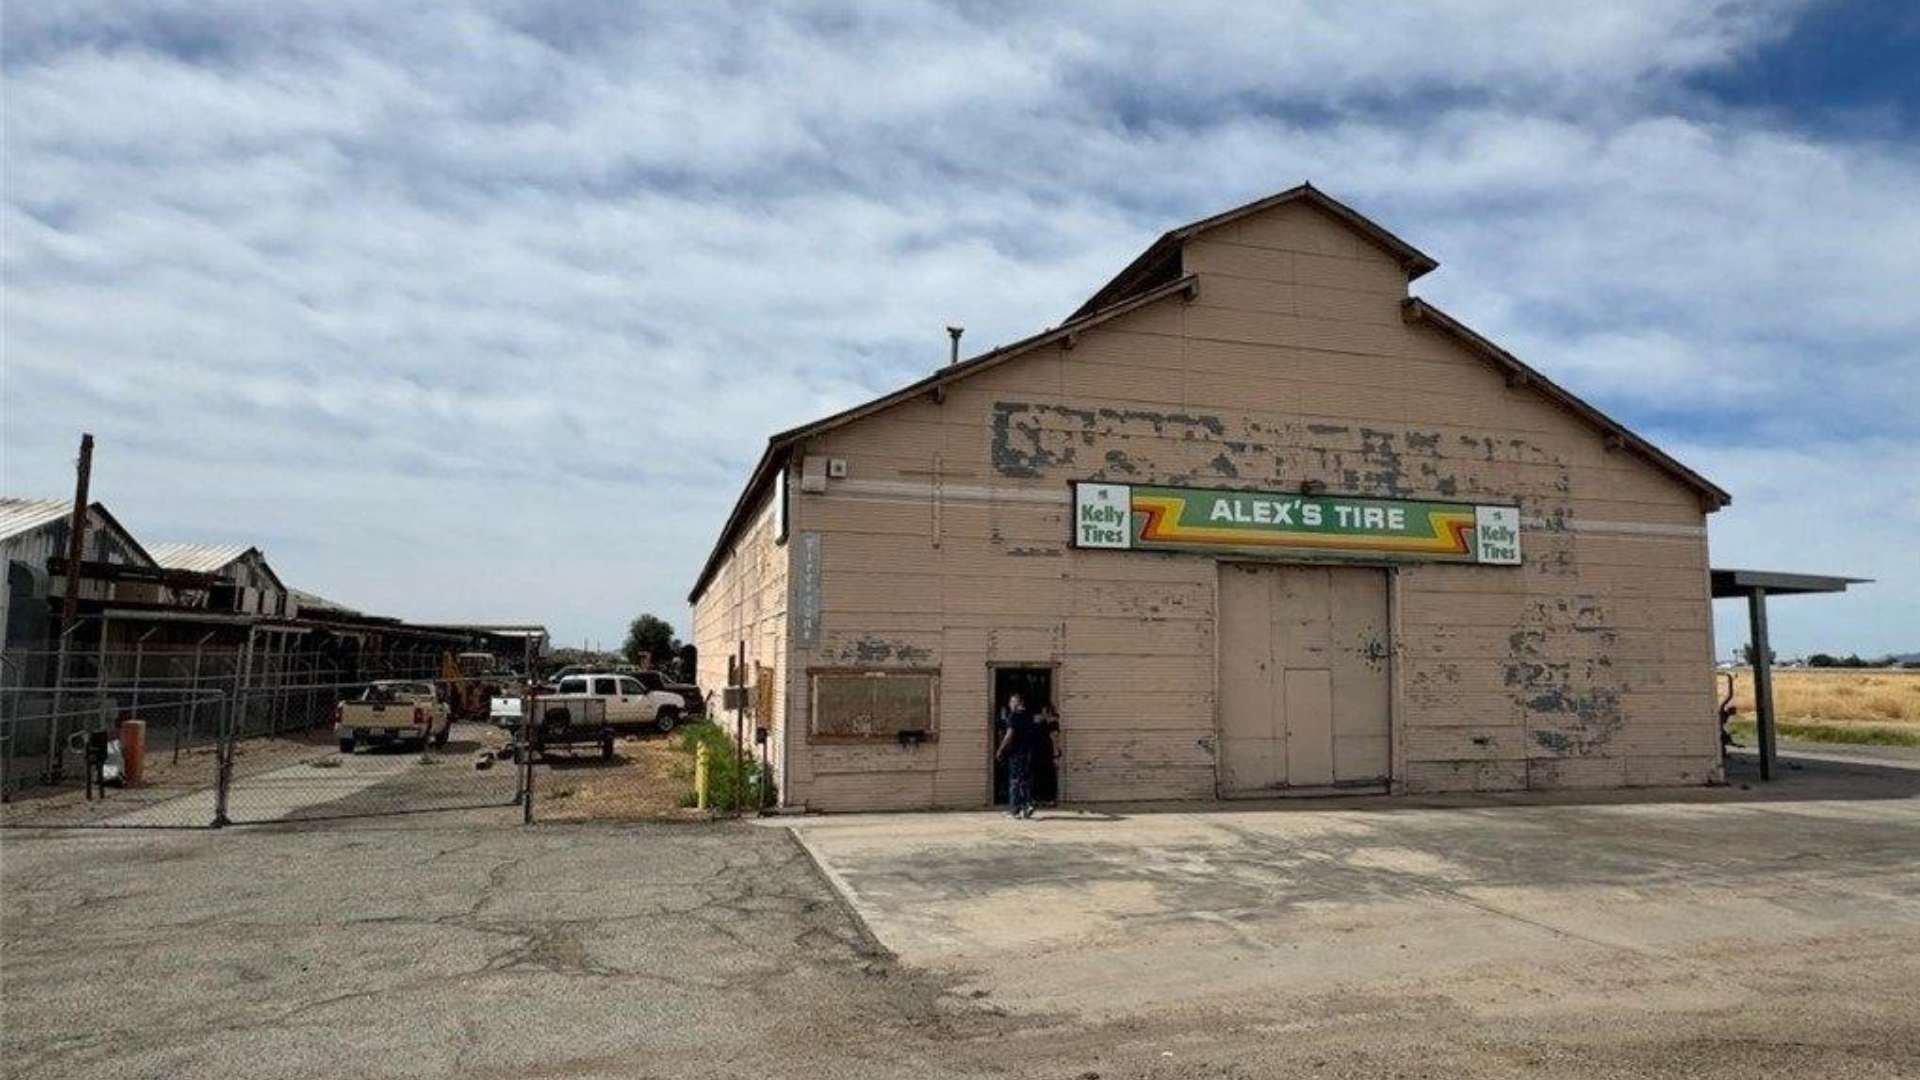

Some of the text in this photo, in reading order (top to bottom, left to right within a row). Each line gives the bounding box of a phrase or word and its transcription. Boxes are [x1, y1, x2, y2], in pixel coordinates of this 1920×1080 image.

[1081, 503, 1125, 528] Kelly
[1210, 498, 1406, 530] ALEX'S TIRE
[1081, 523, 1123, 543] Tires
[1480, 525, 1516, 545] Kelly
[1482, 543, 1516, 559] Tires
